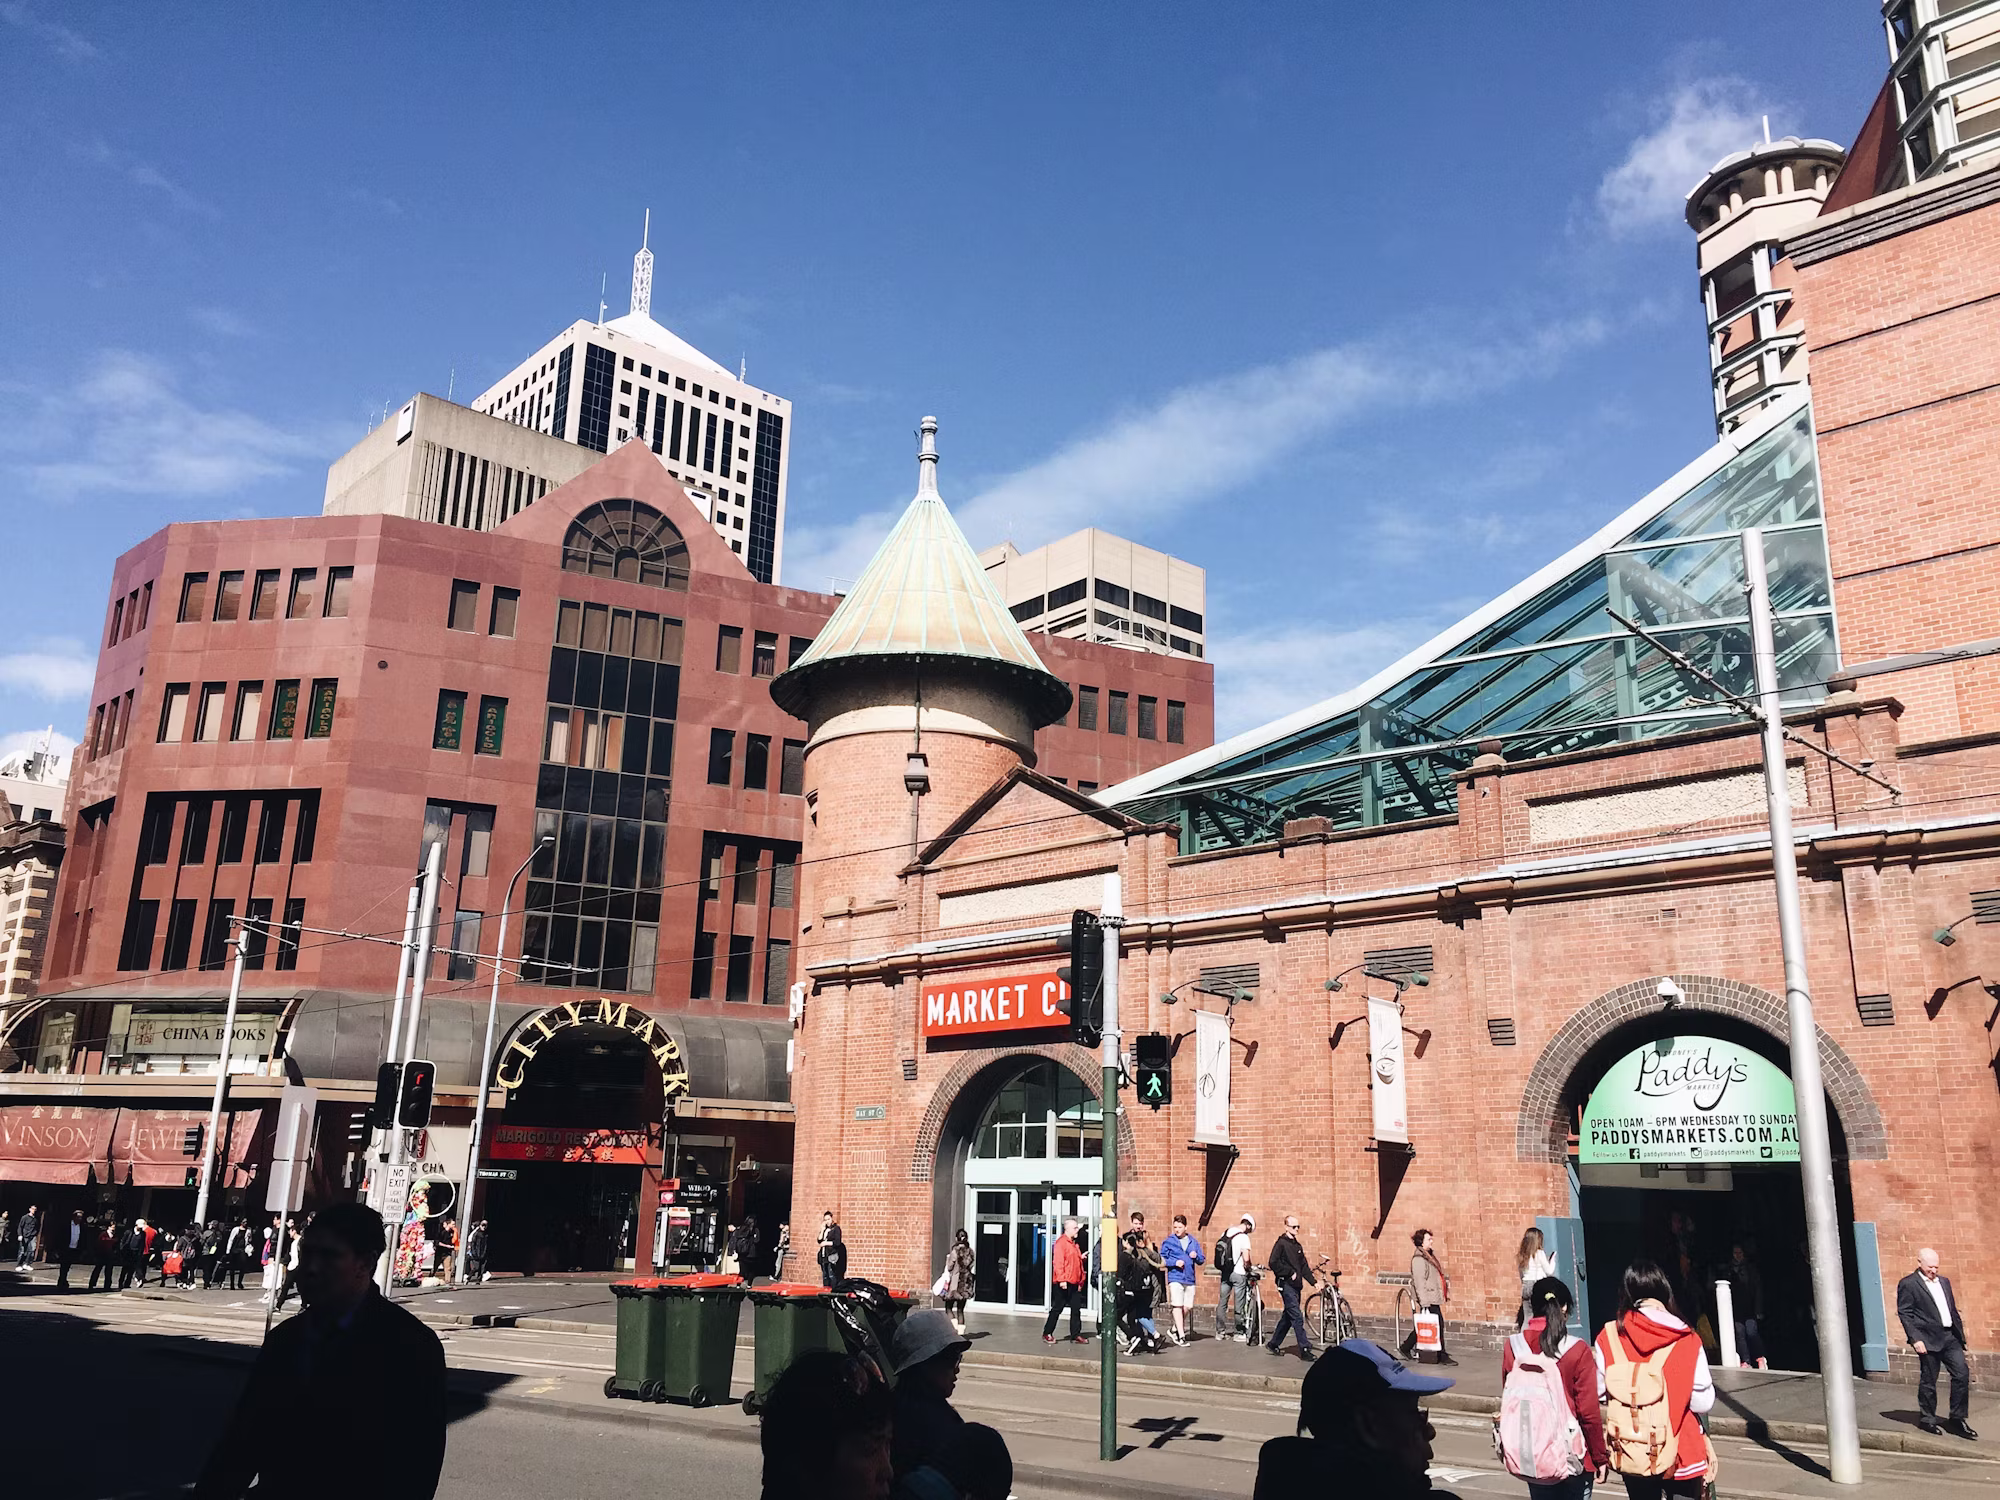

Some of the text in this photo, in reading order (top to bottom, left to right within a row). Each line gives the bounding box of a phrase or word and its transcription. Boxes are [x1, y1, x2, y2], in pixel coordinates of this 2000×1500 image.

[927, 983, 1029, 1027] MARKET
[163, 1027, 209, 1040] CHINA
[215, 1028, 266, 1041] BOKS
[496, 997, 690, 1097] CITYMARK
[1634, 1047, 1748, 1111] Paddy's
[1590, 1118, 1615, 1129] OPEN
[1618, 1117, 1644, 1128] 10AM
[1655, 1116, 1677, 1127] 6PM
[1680, 1115, 1740, 1126] WEDNESDAY
[1743, 1114, 1756, 1126] TO
[2, 1115, 94, 1148] VINSON
[495, 1128, 561, 1144] MARIGOLD
[1643, 1150, 1686, 1158] paddysmarkets
[392, 1168, 404, 1178] NO
[388, 1178, 406, 1188] EXIT
